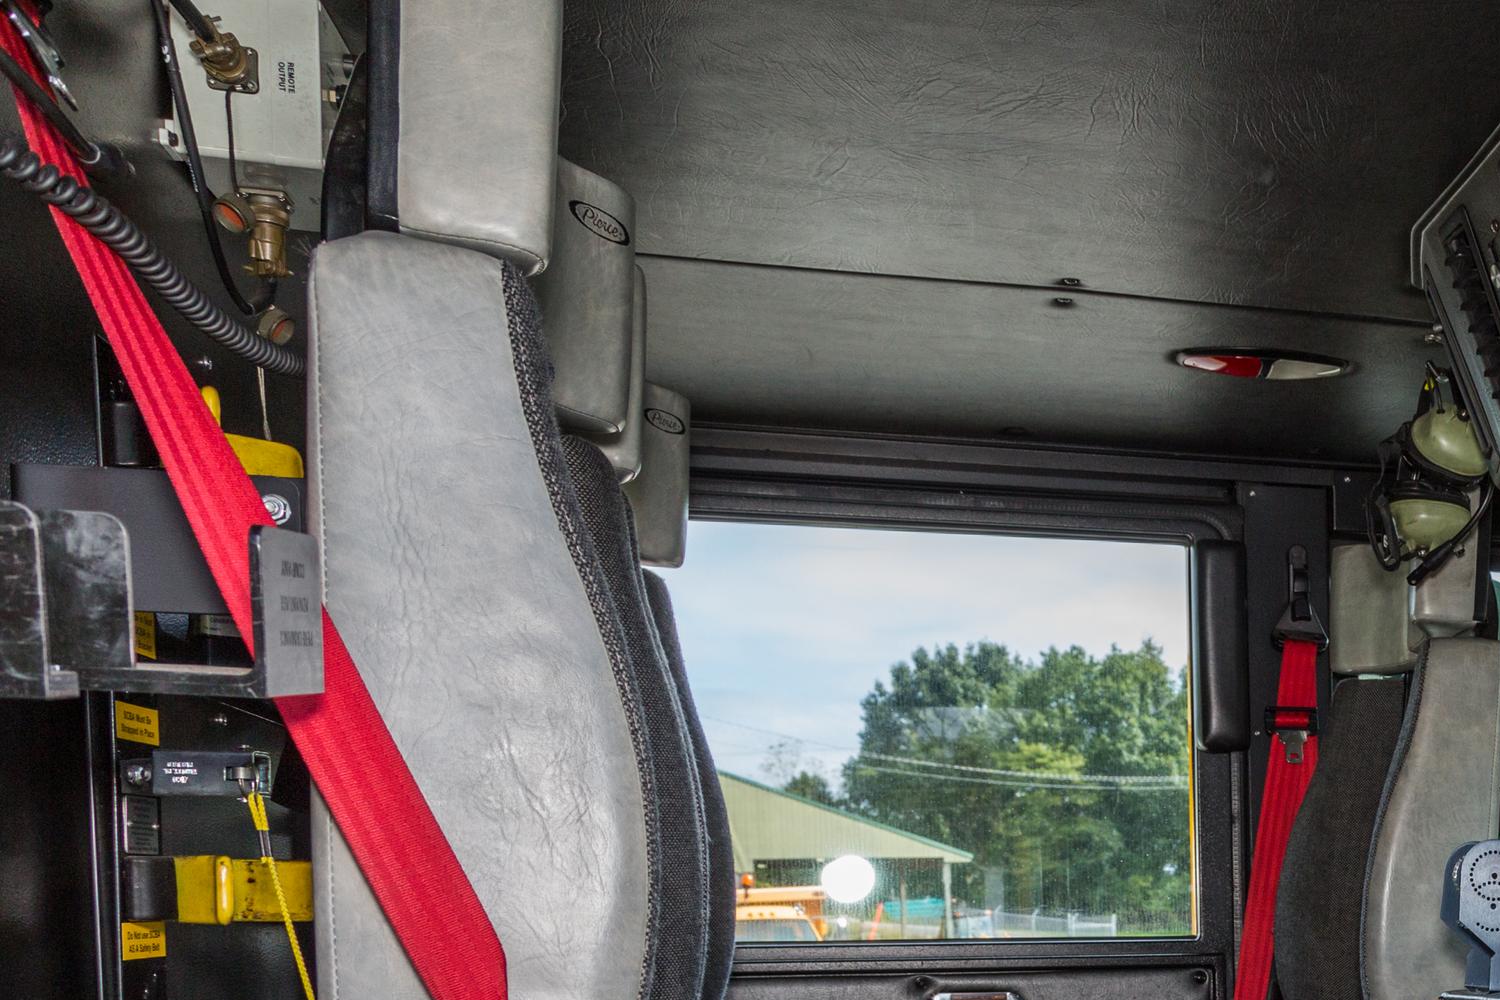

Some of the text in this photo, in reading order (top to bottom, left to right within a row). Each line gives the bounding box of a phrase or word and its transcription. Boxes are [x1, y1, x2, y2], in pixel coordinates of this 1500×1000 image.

[278, 62, 286, 92] OUTPUT
[287, 62, 296, 94] REMOTE
[581, 206, 621, 239] Pierce
